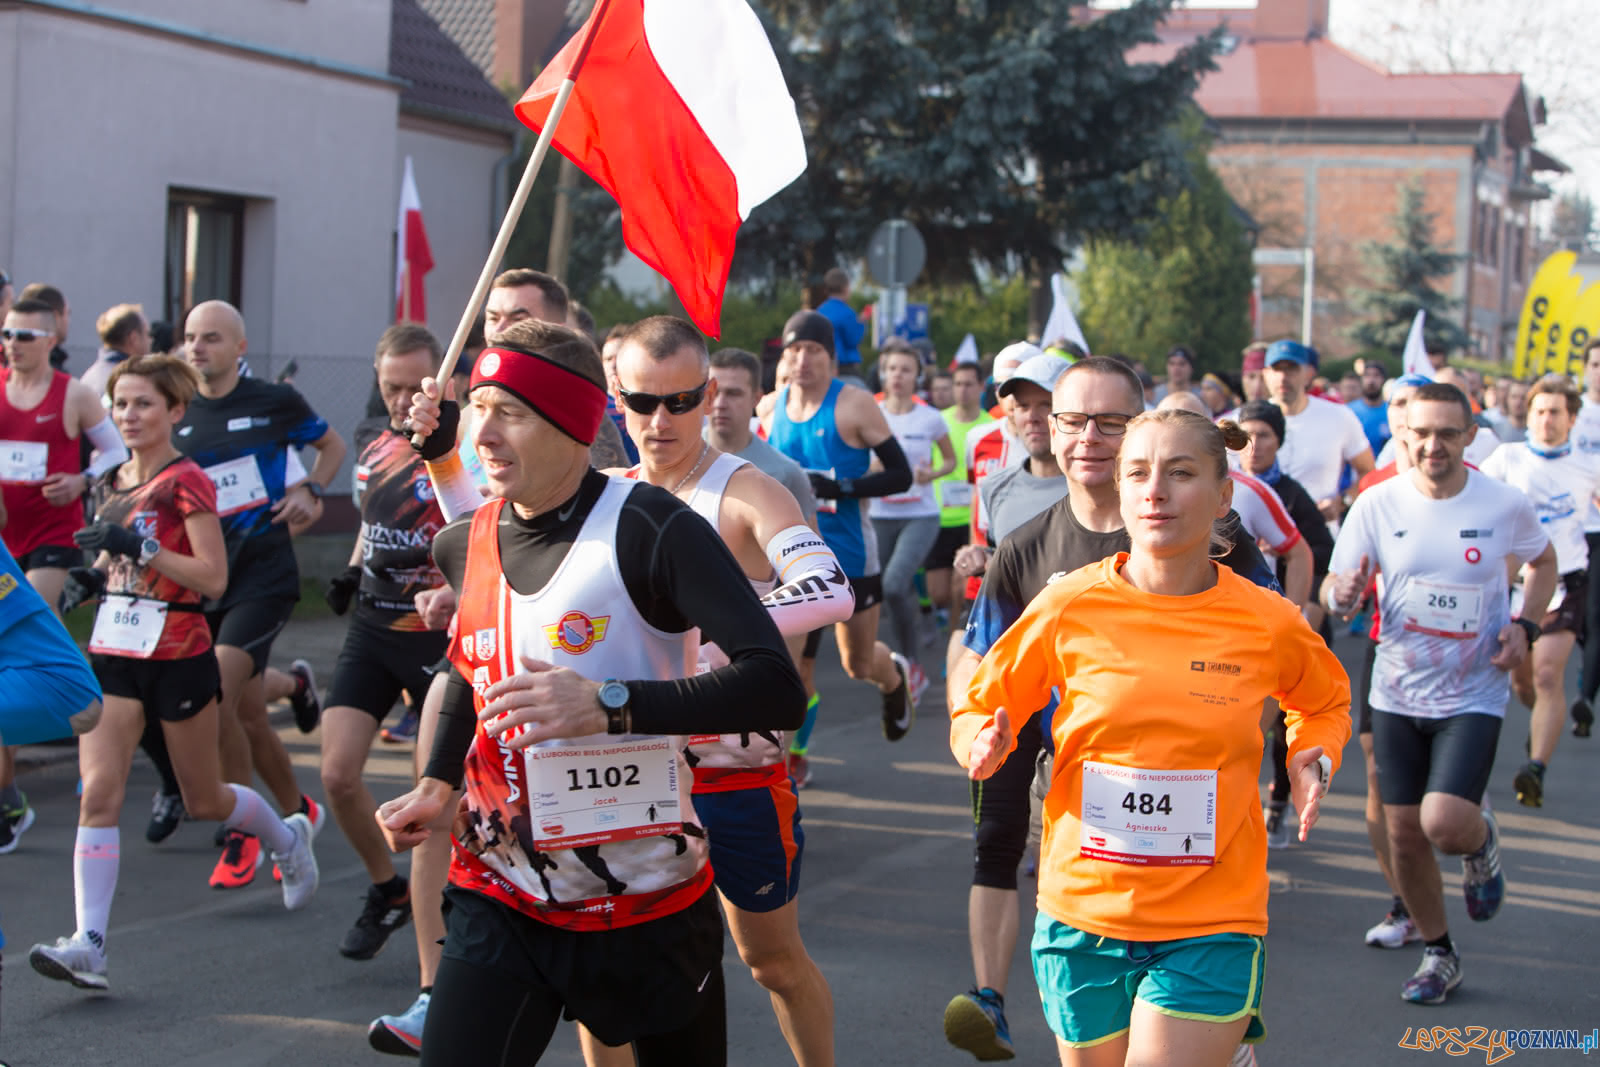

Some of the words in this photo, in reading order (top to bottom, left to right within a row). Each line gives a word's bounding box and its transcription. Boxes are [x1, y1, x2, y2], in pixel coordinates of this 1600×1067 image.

[1428, 593, 1457, 609] 265
[114, 611, 139, 626] 866
[1208, 662, 1241, 673] TRIATHLON
[541, 749, 581, 759] LUBOŃSKI
[583, 748, 601, 757] BIEG
[603, 742, 670, 754] NIEPODLEGŁOŚCI
[566, 764, 641, 792] 1102
[669, 765, 677, 791] STREFA
[1097, 768, 1130, 779] LUBOŃSKI
[1149, 774, 1210, 782] NIEPODLEGŁOŚCI
[592, 796, 619, 806] Jacek
[1122, 792, 1173, 815] 484
[1126, 822, 1168, 832] Agnieszka
